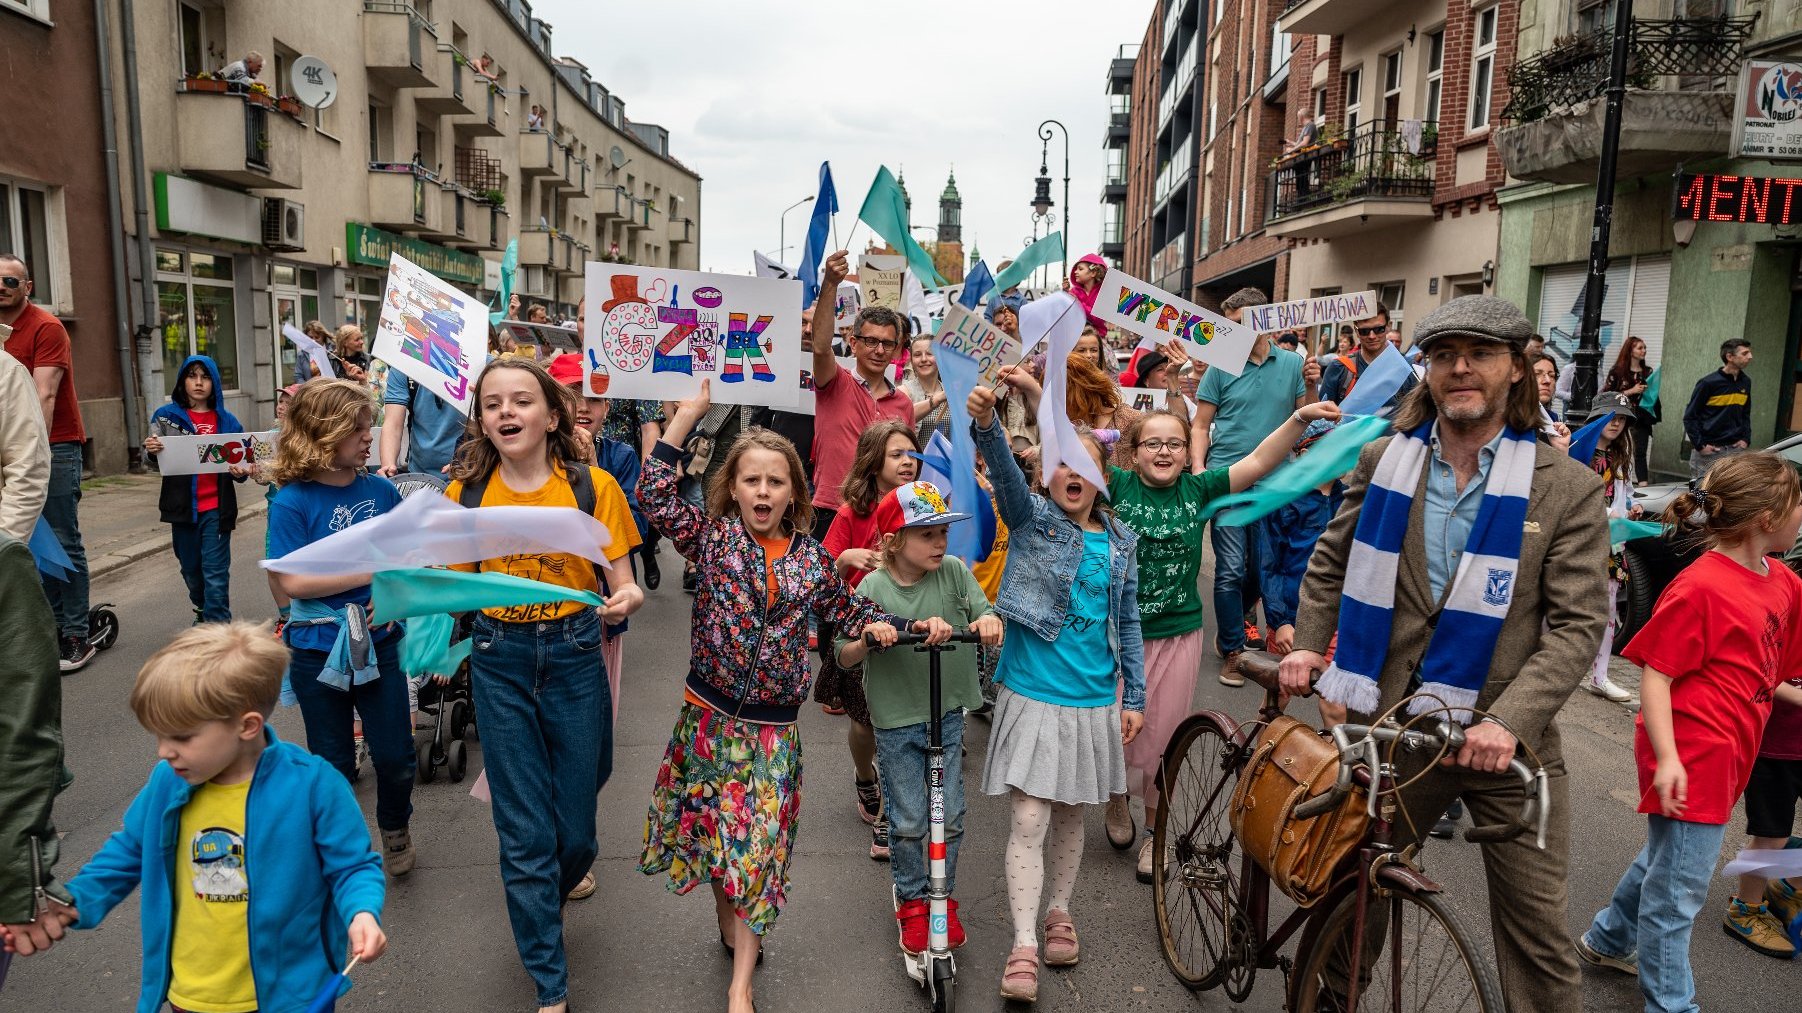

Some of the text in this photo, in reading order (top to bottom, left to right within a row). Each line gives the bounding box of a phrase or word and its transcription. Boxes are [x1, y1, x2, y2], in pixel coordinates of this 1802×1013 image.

[303, 66, 322, 80] 4K
[1744, 132, 1774, 143] HURT
[360, 228, 390, 260] Świat
[1117, 286, 1214, 345] WYRKO
[1251, 307, 1273, 331] NIE
[1313, 295, 1368, 323] MIĄGWA
[957, 315, 1014, 366] LUBIĘ
[203, 843, 217, 853] UA
